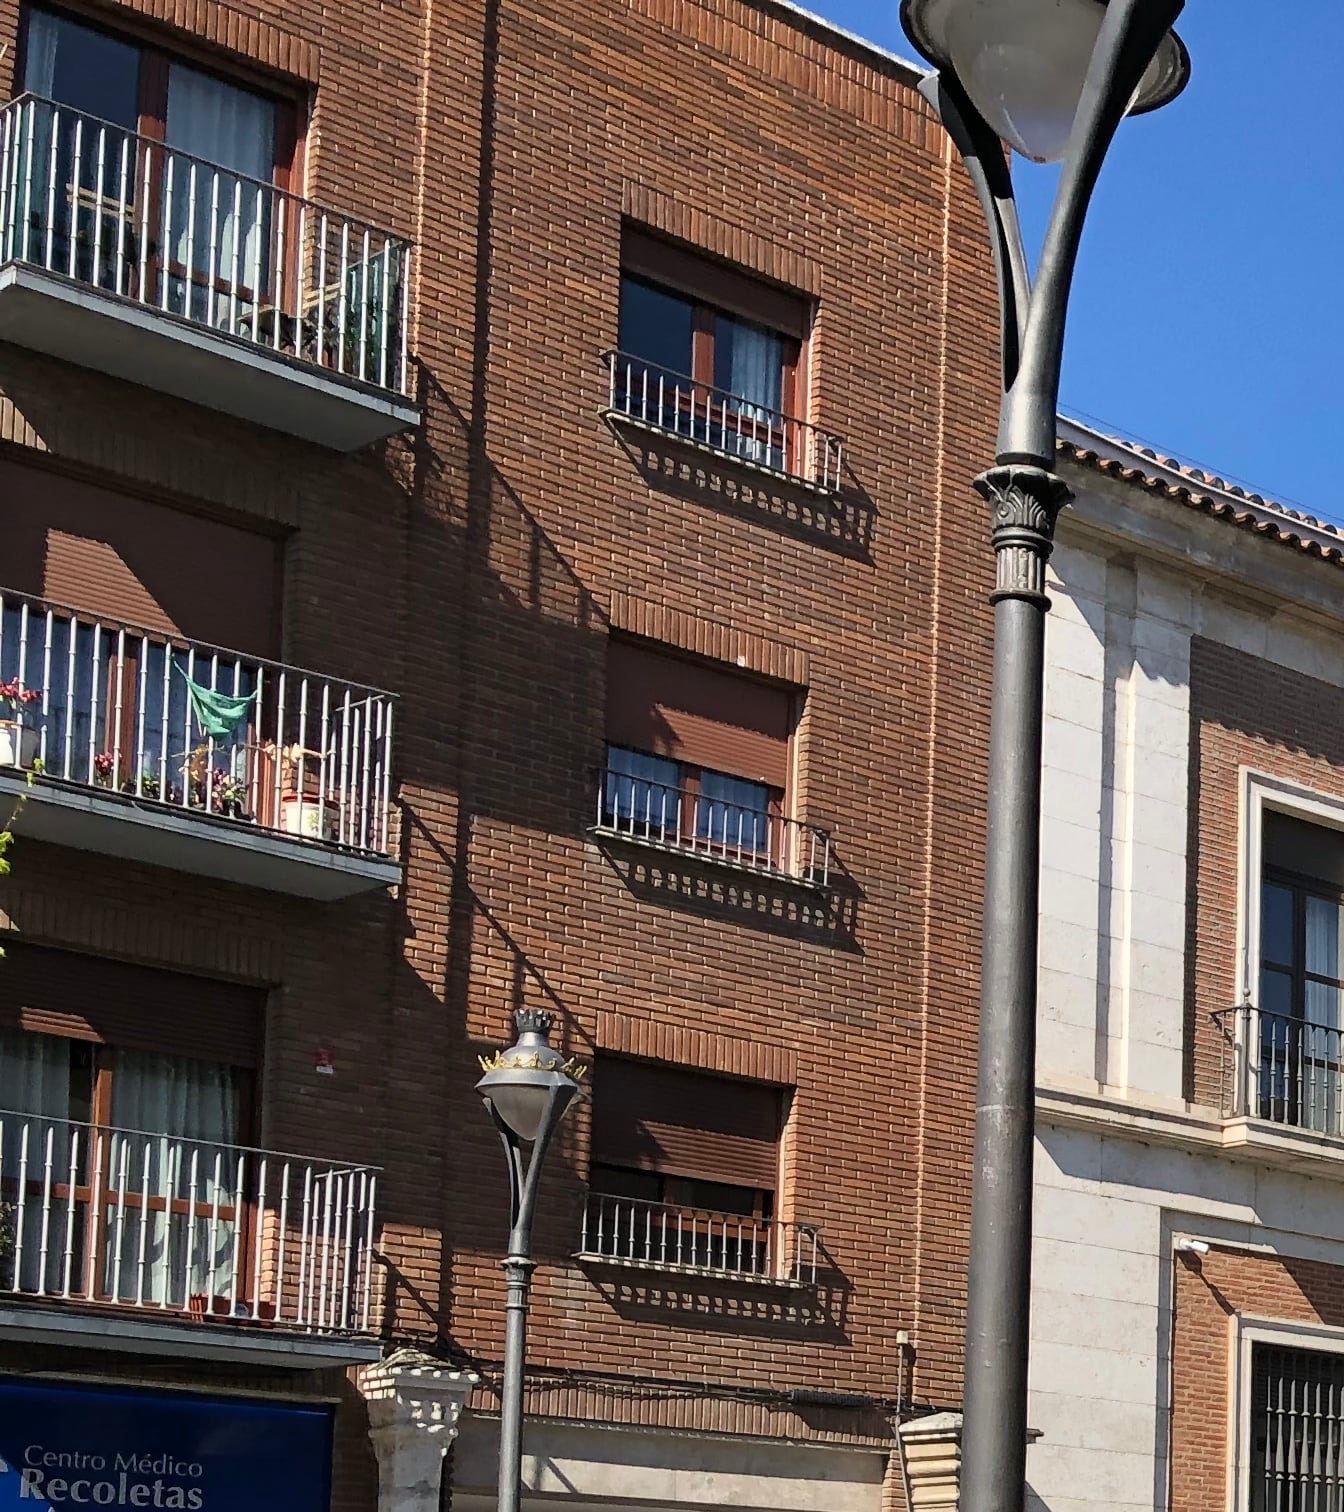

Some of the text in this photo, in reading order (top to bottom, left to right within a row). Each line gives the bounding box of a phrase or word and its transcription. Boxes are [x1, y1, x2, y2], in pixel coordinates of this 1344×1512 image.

[24, 1445, 204, 1478] Centro Médico
[19, 1467, 204, 1511] Recoletas
